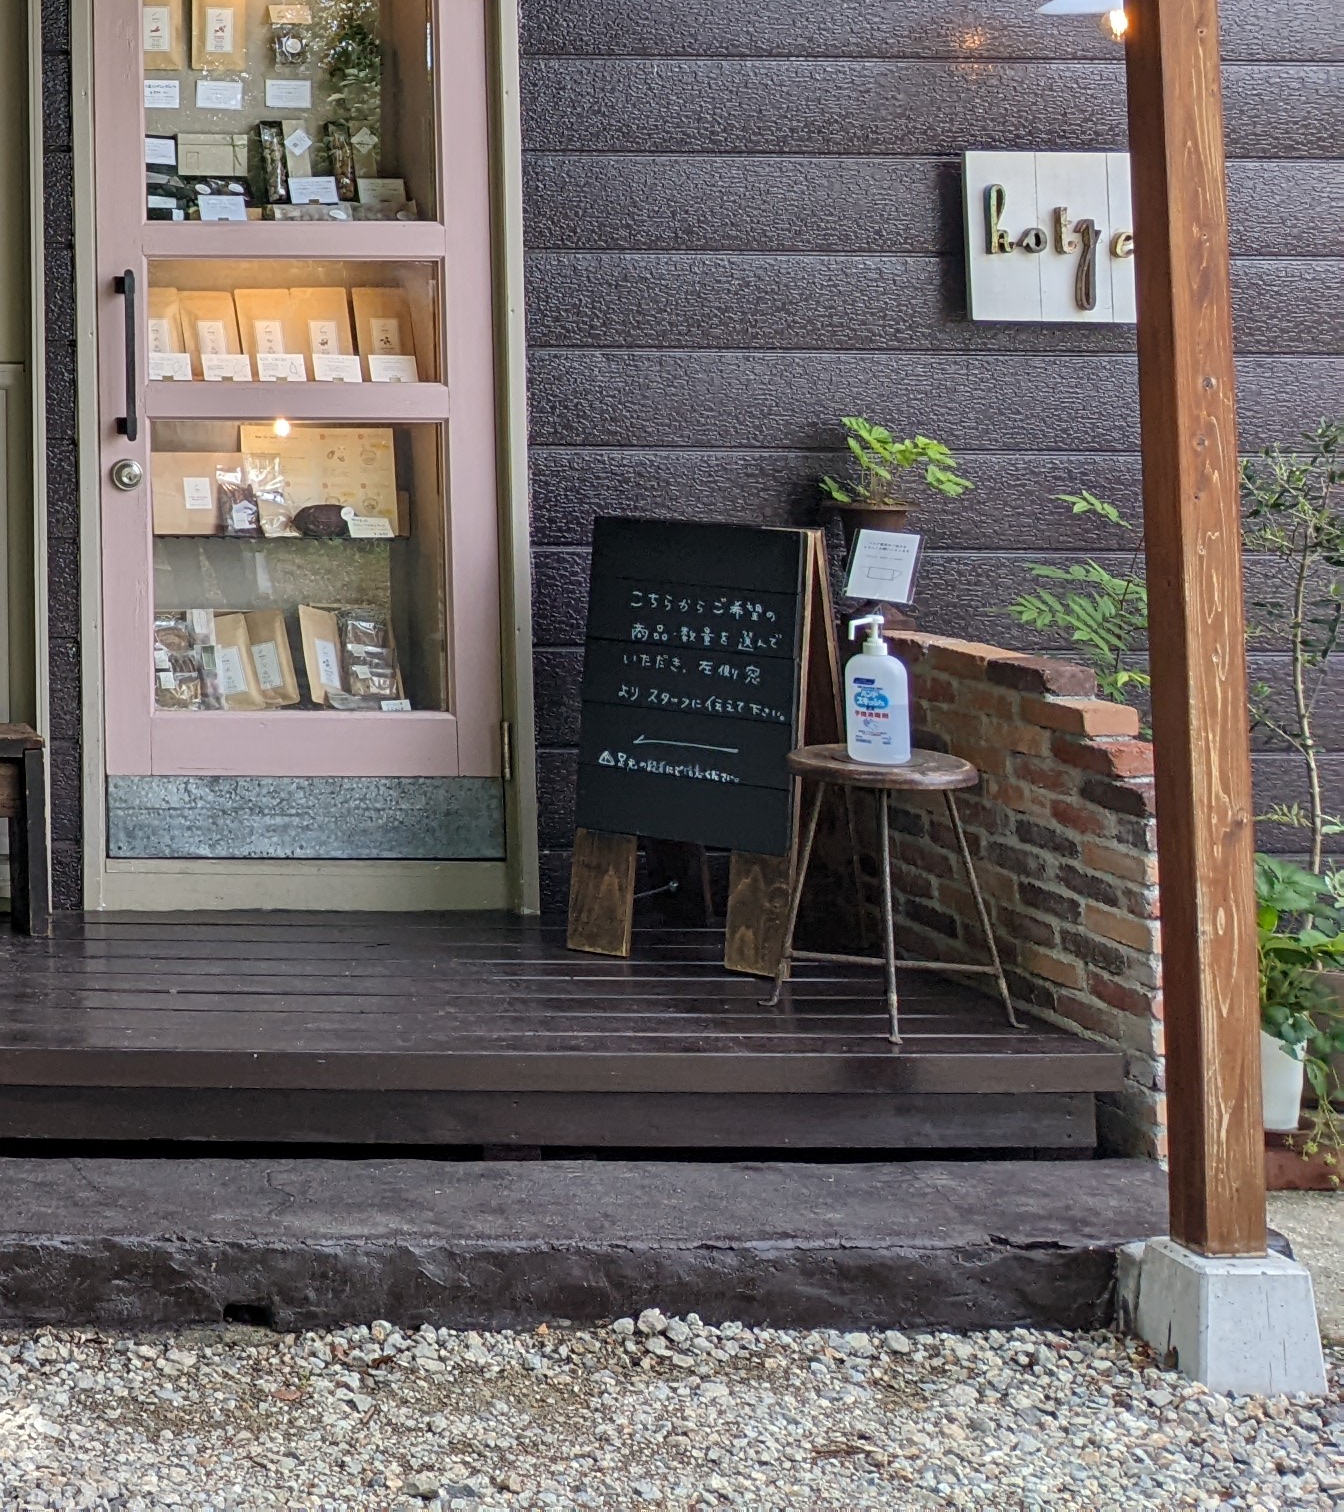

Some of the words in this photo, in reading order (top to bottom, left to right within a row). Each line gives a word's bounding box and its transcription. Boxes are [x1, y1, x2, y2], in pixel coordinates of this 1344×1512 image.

[630, 590, 776, 622] こちらからご希望の
[631, 622, 783, 651] 商品・数量を選んで
